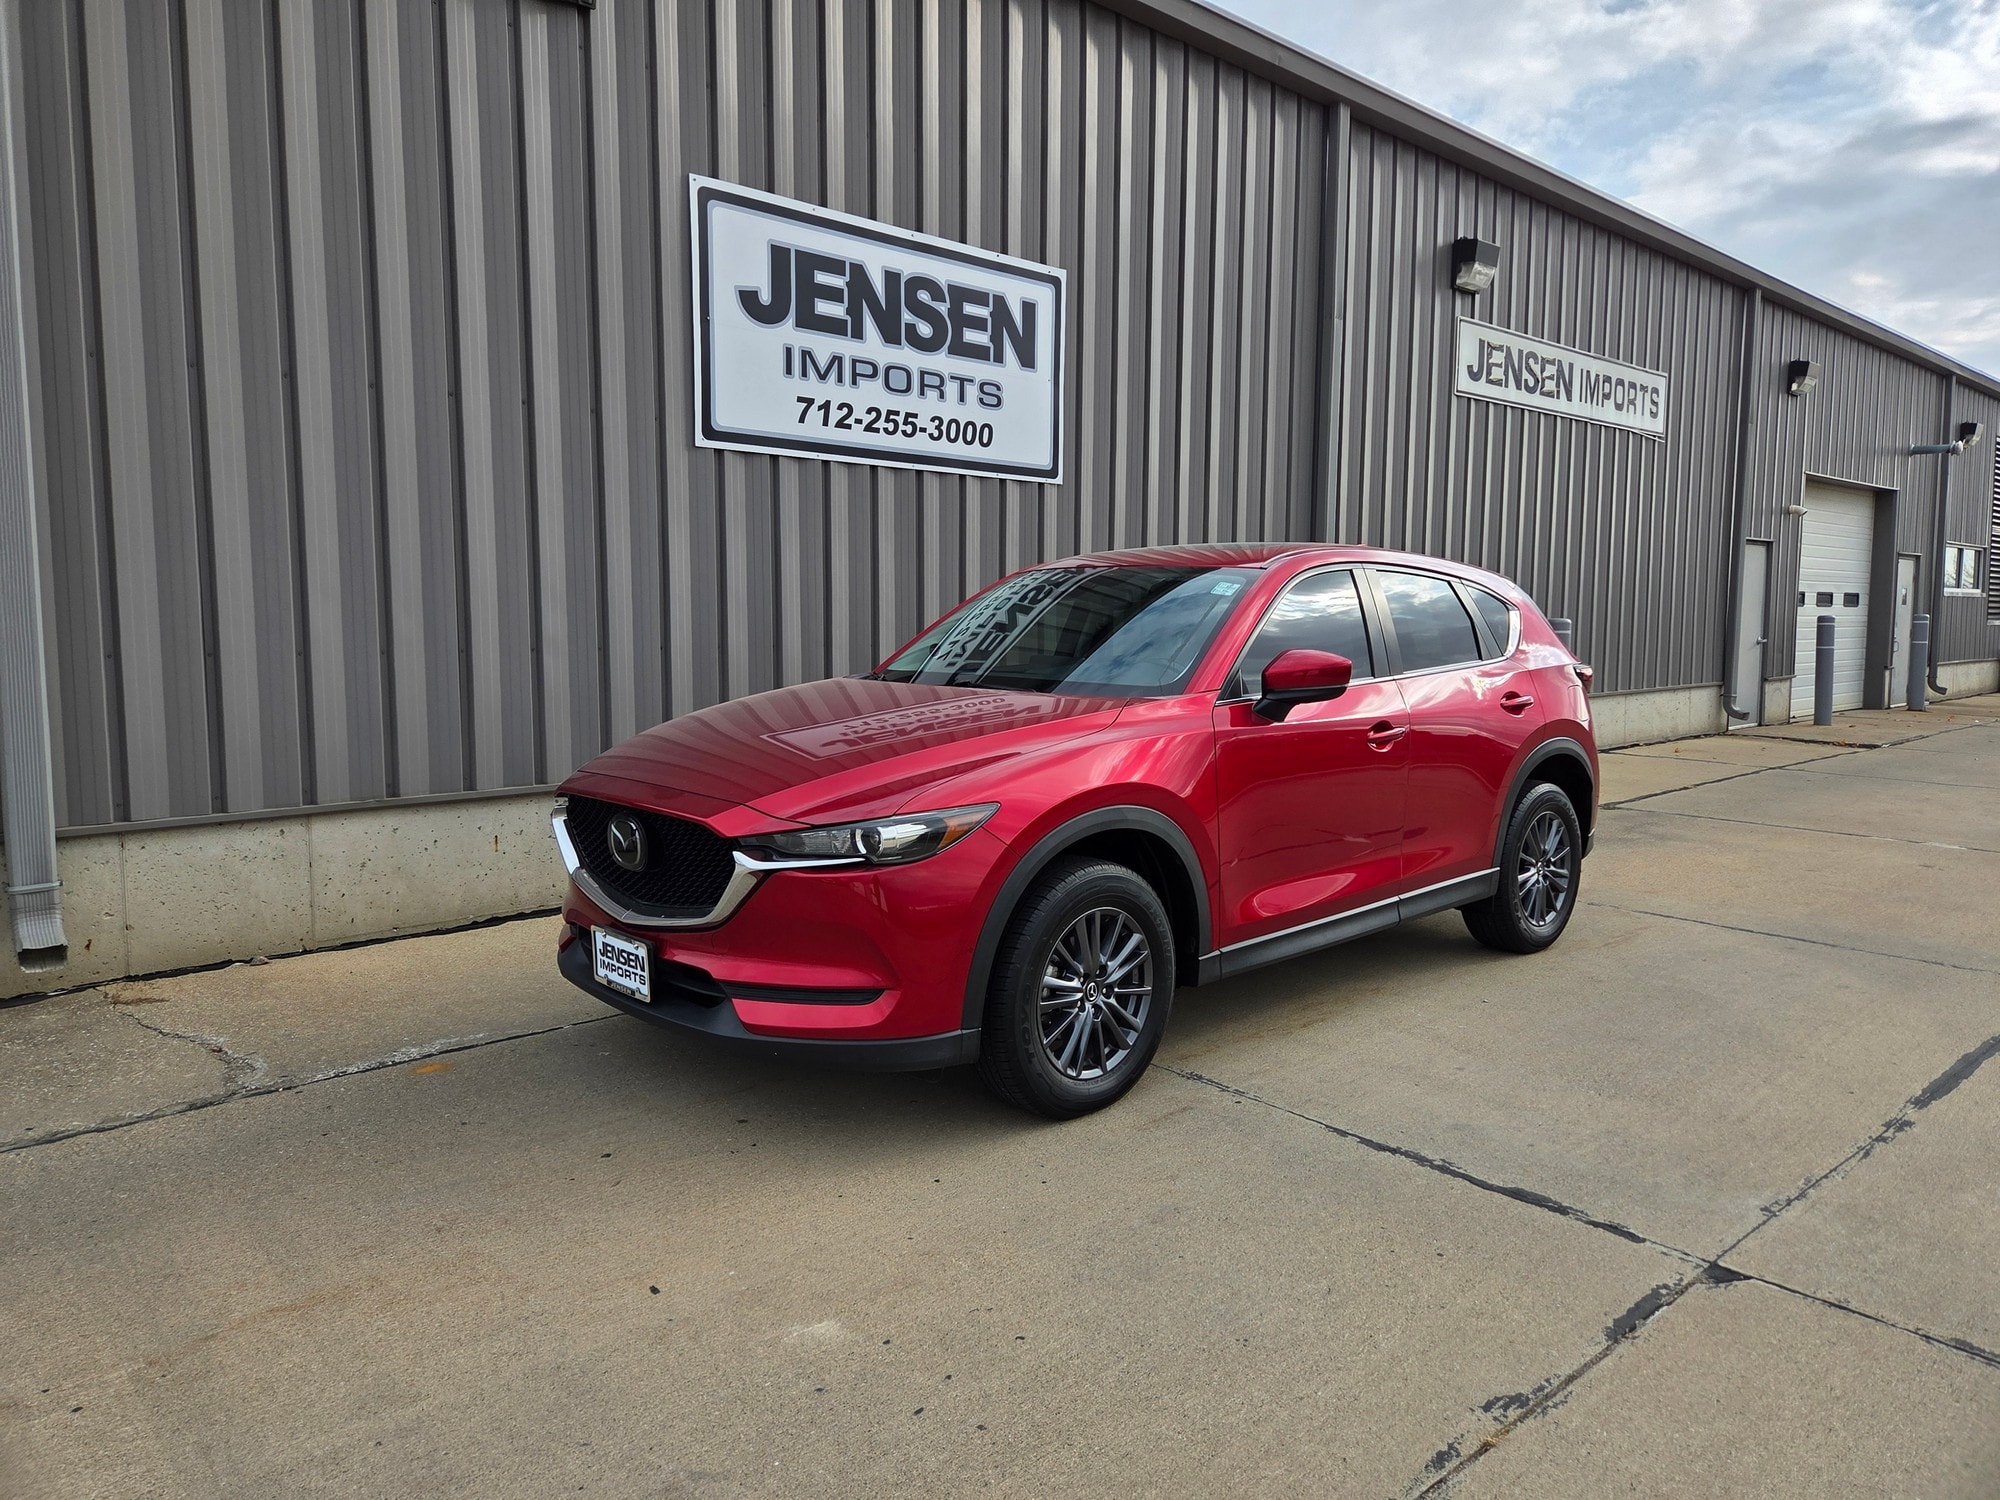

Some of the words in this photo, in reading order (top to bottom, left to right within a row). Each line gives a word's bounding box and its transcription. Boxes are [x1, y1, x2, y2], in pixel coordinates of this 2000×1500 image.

[736, 241, 1037, 371] JENSEN
[784, 345, 1003, 409] IMPORTS
[1467, 338, 1574, 402] JENSEN
[1579, 368, 1659, 419] IMPORTS
[796, 396, 993, 448] 712-255-3000
[599, 941, 645, 972] JENSEN
[600, 959, 646, 985] IMPORTS
